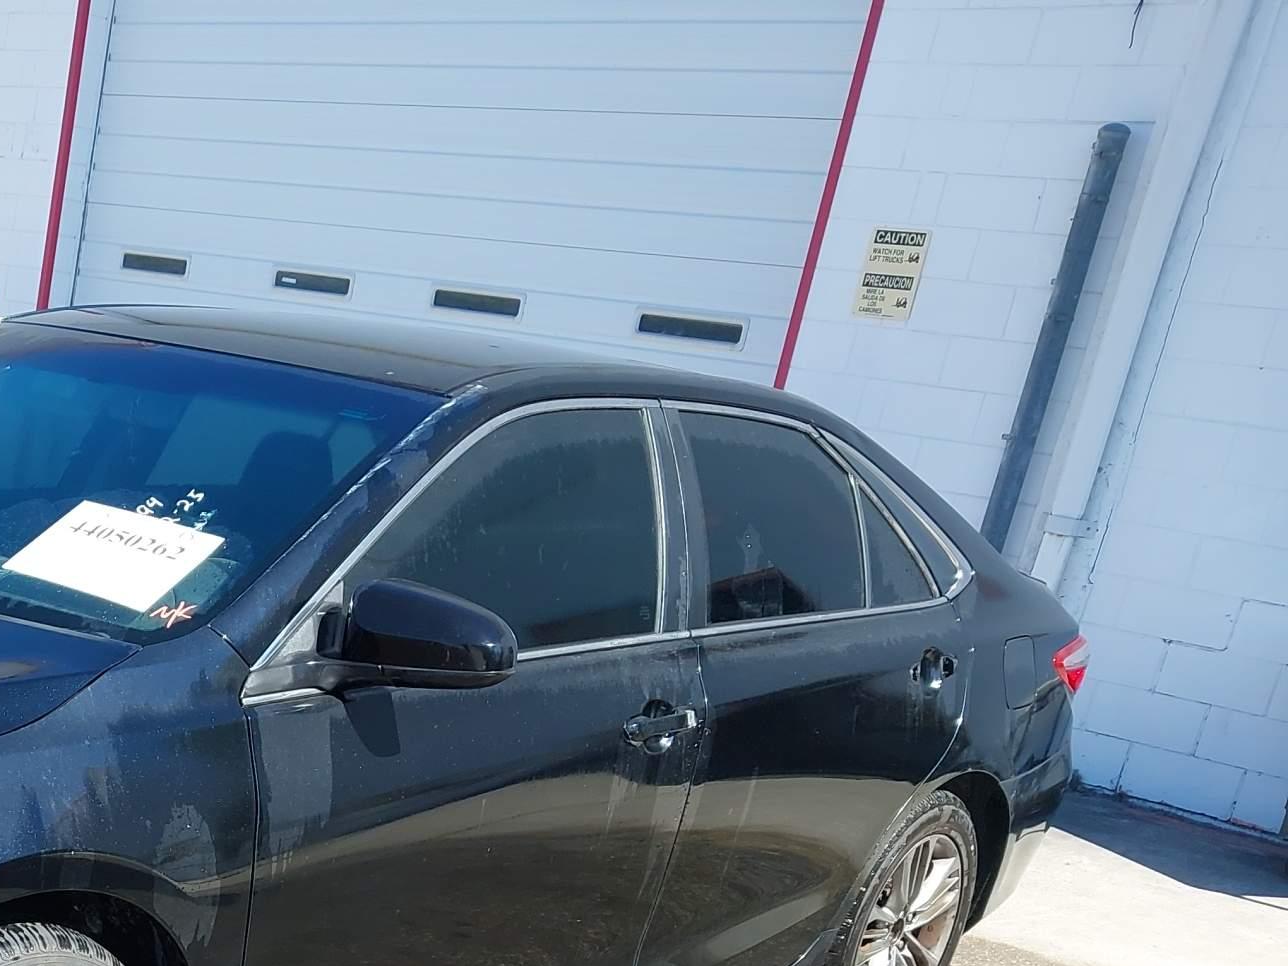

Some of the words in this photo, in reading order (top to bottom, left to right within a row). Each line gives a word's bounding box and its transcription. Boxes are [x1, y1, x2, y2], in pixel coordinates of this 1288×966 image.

[876, 231, 926, 246] CAUTION
[872, 247, 892, 255] WATCH
[893, 248, 905, 256] FOR
[882, 256, 904, 264] TRUCKS
[863, 274, 914, 289] PRECAUCION
[69, 520, 186, 560] 44050262
